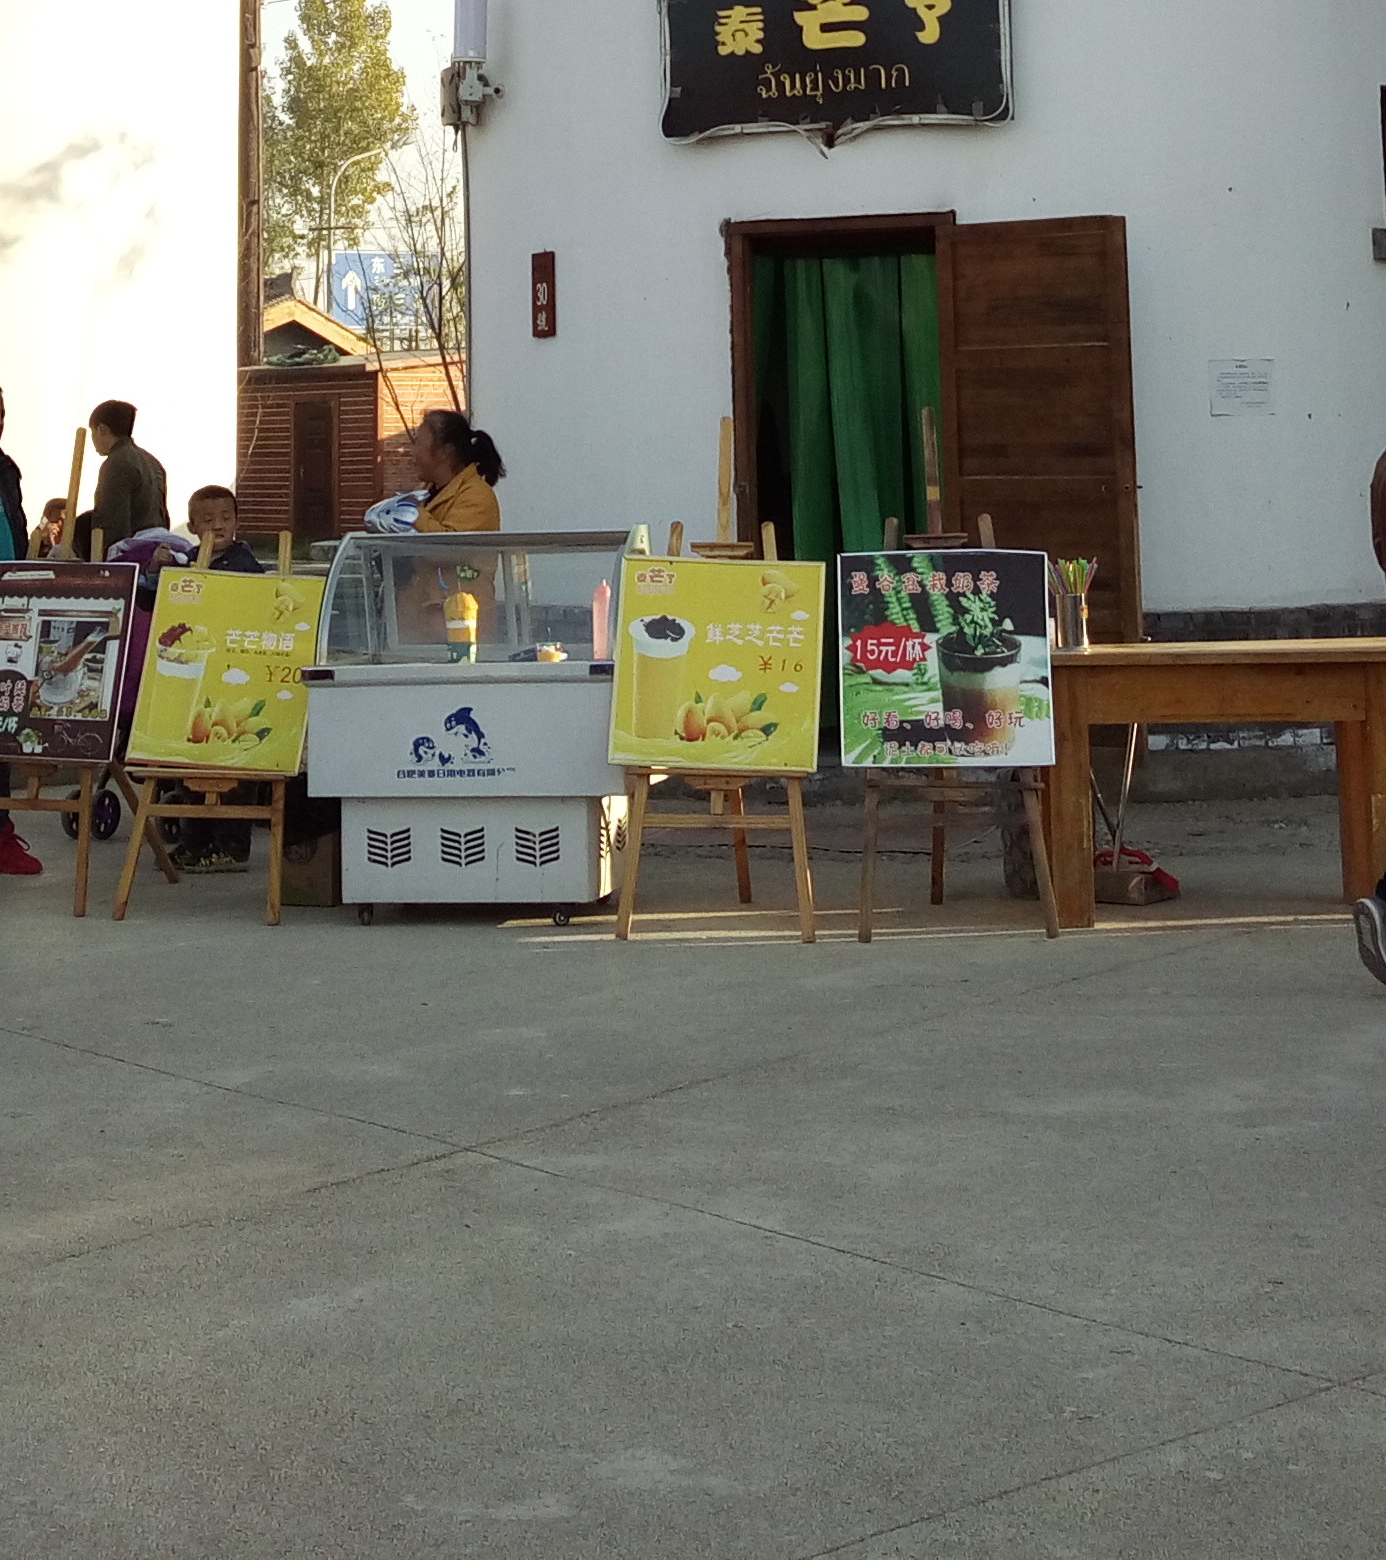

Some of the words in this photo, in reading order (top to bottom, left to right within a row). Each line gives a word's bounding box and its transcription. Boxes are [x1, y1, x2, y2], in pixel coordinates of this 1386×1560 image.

[756, 62, 912, 105] ฉันยุ่งมาก
[851, 571, 1000, 594] 曼谷盆栽奶茶
[705, 622, 806, 648] 鲜芝芝芒芒
[854, 637, 925, 663] 15元/杯
